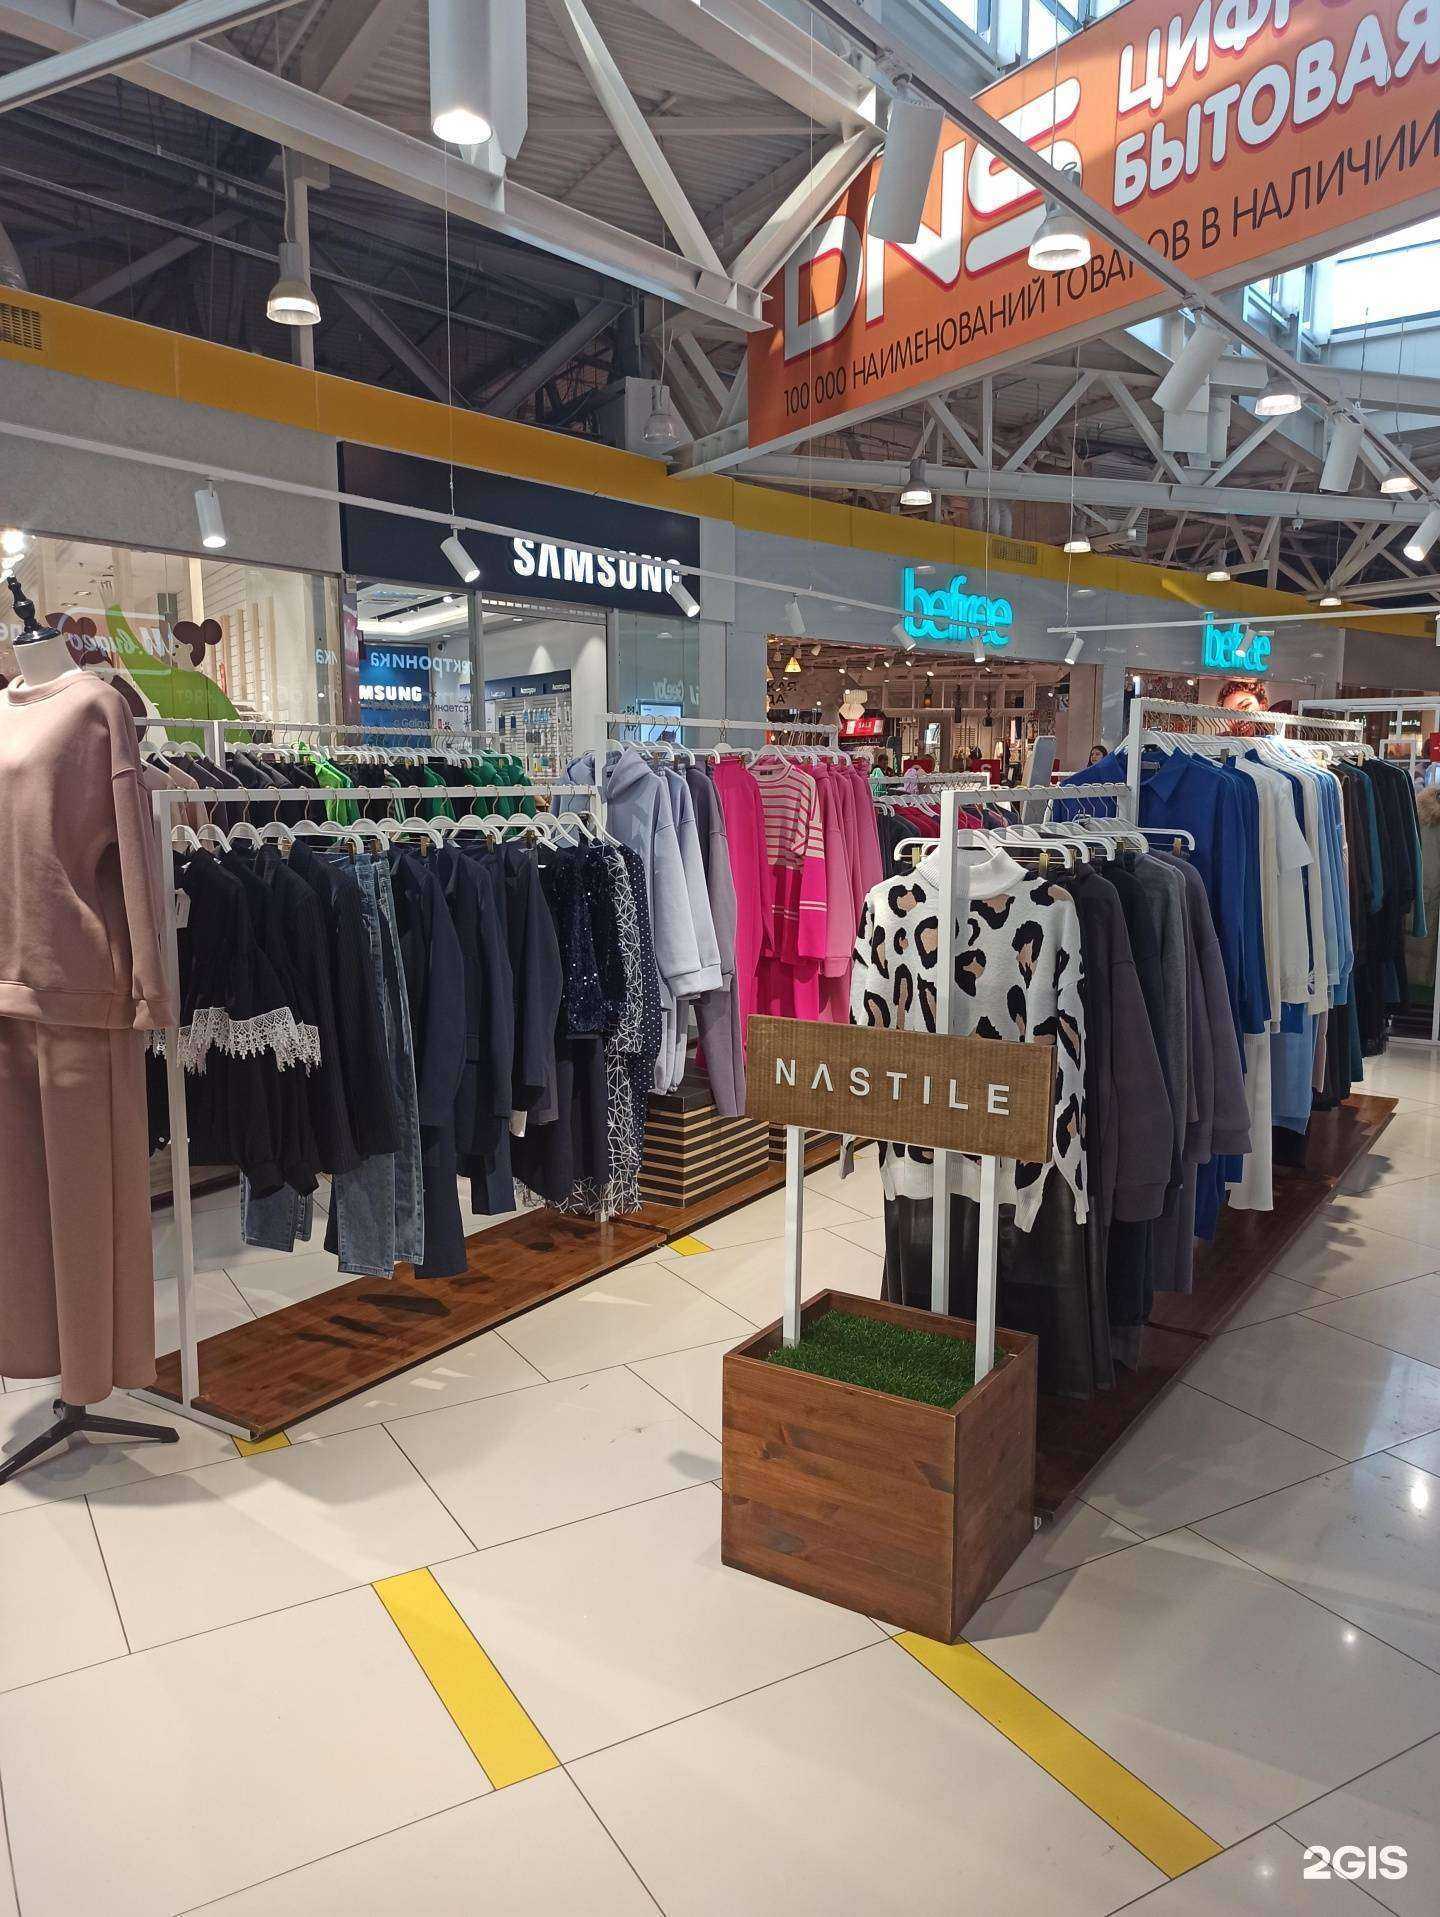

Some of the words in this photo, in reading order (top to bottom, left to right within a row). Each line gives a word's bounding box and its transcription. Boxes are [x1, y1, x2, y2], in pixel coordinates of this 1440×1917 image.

[1113, 1, 1440, 207] БЫТОВАЯ
[1118, 0, 1290, 114] ЦИФ
[784, 76, 1083, 362] DNS
[784, 383, 810, 417] 100
[814, 366, 847, 405] 000
[853, 277, 1045, 390] НАИМЕНОВАНИЙ
[1052, 220, 1190, 305] ТОВАОВ
[1201, 206, 1221, 249] В
[1233, 110, 1440, 237] НАЛИЧИИ
[359, 685, 422, 701] MSUNG
